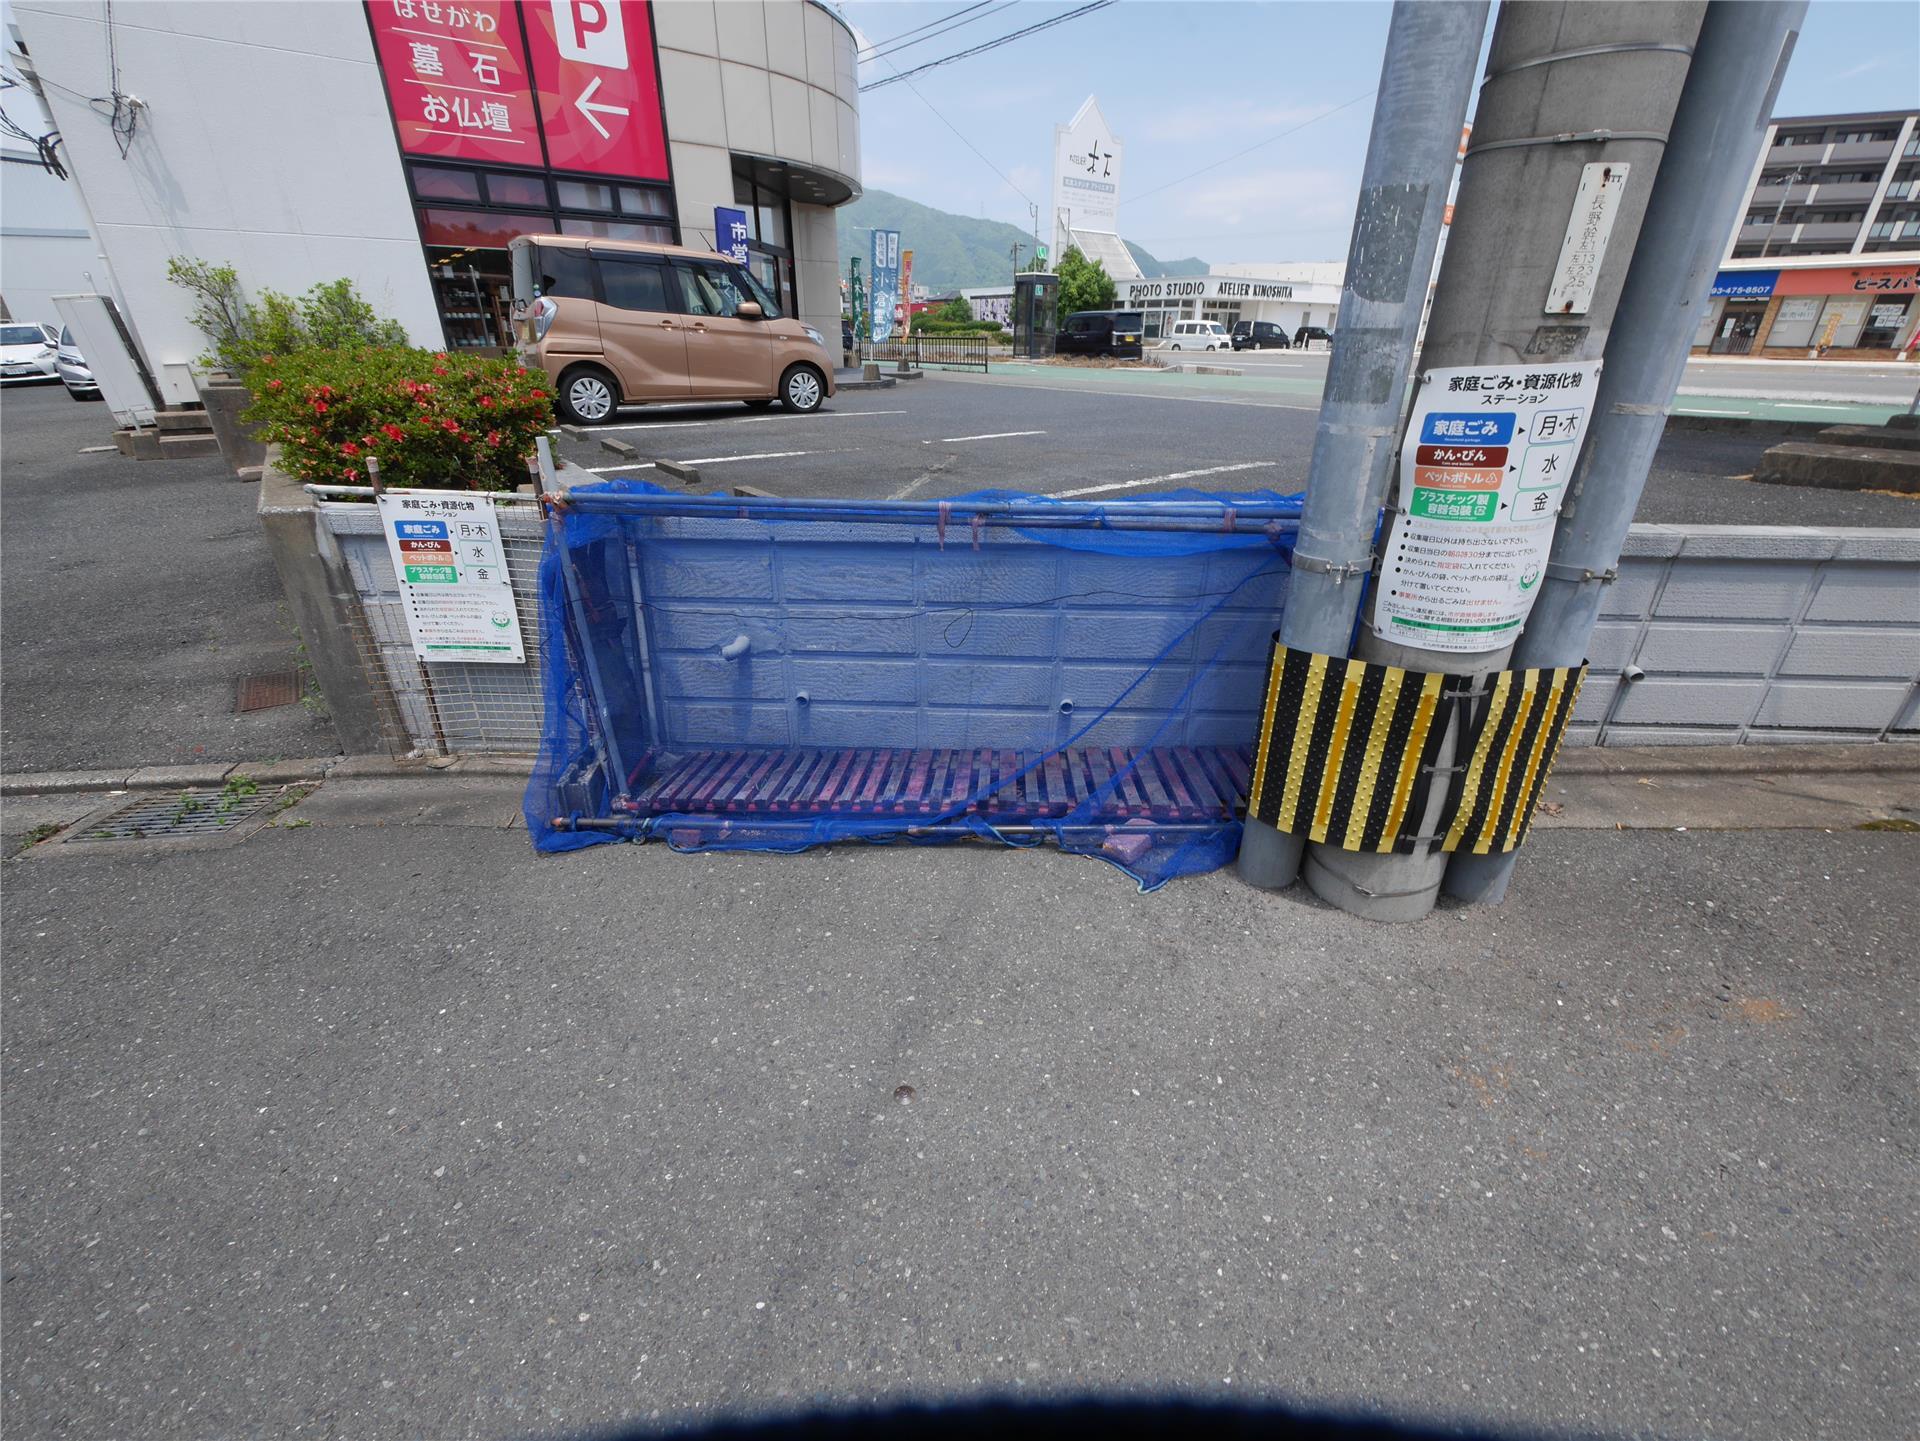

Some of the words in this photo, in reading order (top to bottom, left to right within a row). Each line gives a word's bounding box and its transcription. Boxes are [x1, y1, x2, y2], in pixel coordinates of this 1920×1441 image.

[393, 0, 497, 33] はせがわ
[571, 0, 608, 50] P
[420, 94, 513, 133] お仏壇
[1129, 284, 1162, 297] PHOTO
[1166, 282, 1205, 296] STUDIO
[1217, 282, 1251, 296] ATELIER
[1252, 284, 1293, 299] KINOSHITA
[1448, 371, 1583, 392] 家庭ごみ・資源化物
[1481, 393, 1549, 405] ステーション
[1433, 420, 1498, 436] 家庭ごみ
[1433, 448, 1487, 461] かん・びん
[1541, 453, 1560, 474] 水
[1425, 471, 1484, 484] ペットボトル
[1420, 489, 1490, 505] プラスチック製
[1532, 492, 1549, 511] 金
[401, 499, 475, 511] 家庭ごみ・資源化物
[425, 510, 458, 518] ステーション
[403, 524, 441, 535] 家庭ごみ
[410, 541, 441, 549] かん・びん
[472, 546, 485, 558] 水
[477, 568, 489, 580] 金
